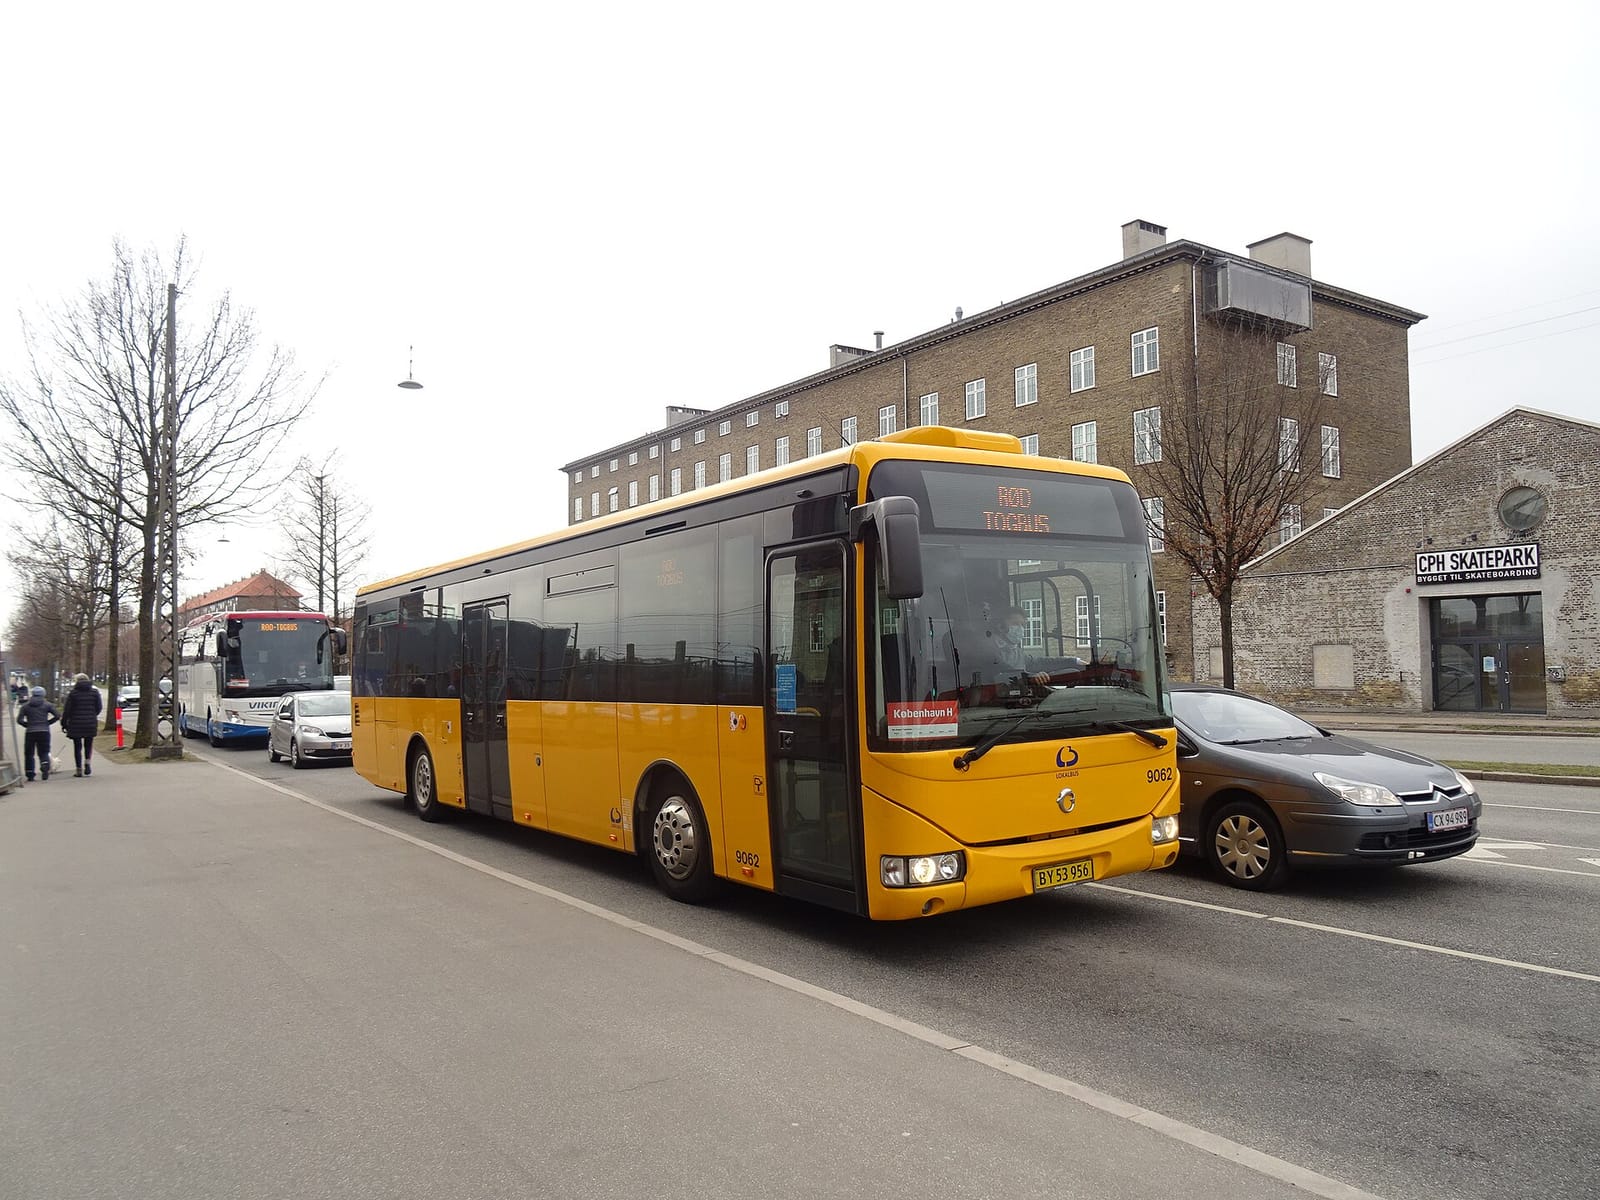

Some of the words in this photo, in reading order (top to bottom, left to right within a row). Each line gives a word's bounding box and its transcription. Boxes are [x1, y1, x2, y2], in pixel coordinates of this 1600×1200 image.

[983, 511, 1050, 533] TOGBUS
[1418, 554, 1445, 572] CPH
[1450, 547, 1536, 571] SKATEPARK
[1417, 574, 1448, 583] BYGGET
[1450, 573, 1463, 581] TIL
[1465, 568, 1538, 580] SKATEBOARDING
[893, 708, 946, 719] København
[946, 707, 953, 717] H
[1055, 770, 1080, 779] LOKALBUS
[1146, 767, 1173, 783] 9062
[1433, 814, 1445, 827] CX
[1445, 812, 1455, 825] 94
[735, 850, 760, 868] 9062
[1039, 869, 1054, 886] BY
[1055, 867, 1069, 882] 53
[1070, 863, 1089, 879] 956
